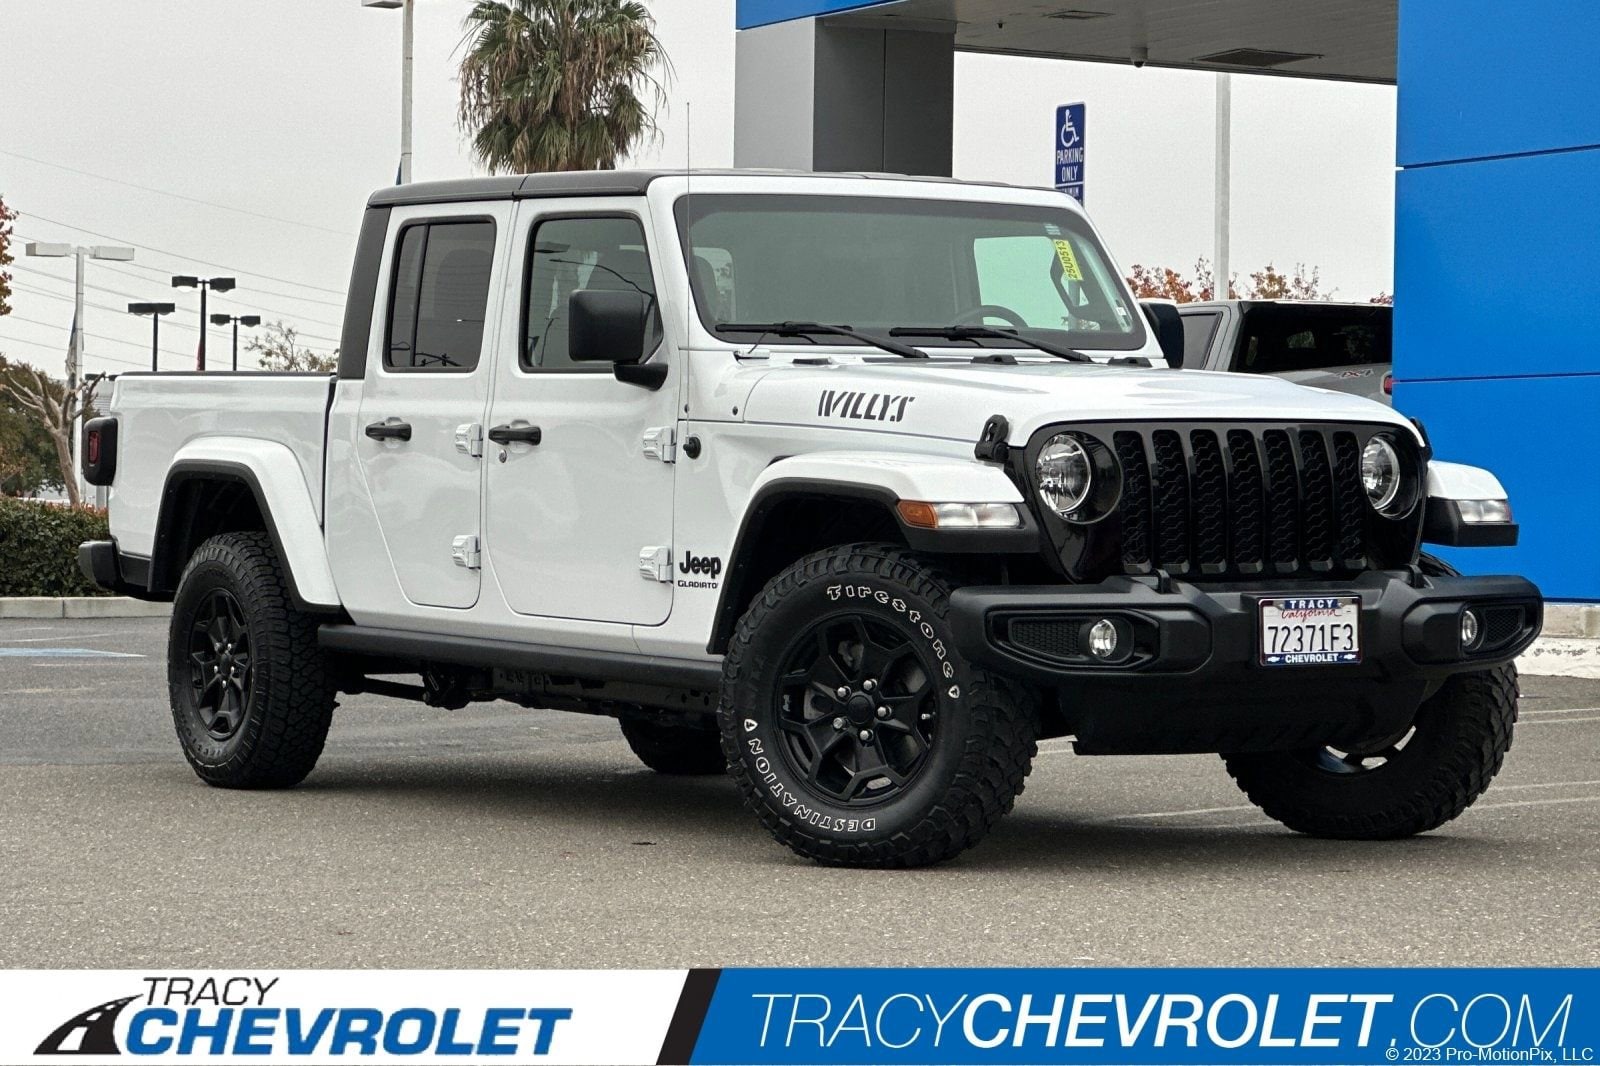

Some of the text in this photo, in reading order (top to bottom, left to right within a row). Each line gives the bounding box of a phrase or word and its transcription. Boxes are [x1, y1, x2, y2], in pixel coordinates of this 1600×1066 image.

[1057, 148, 1083, 164] PARKING
[1062, 166, 1078, 182] ONLY
[818, 390, 915, 422] WILLYS
[679, 551, 721, 579] Jeep
[678, 580, 719, 589] GLADIATO
[1290, 600, 1334, 609] TRACY
[828, 585, 954, 678] Firestone
[1268, 624, 1353, 653] 72371F3
[1285, 653, 1339, 663] CHEVROLET
[748, 738, 876, 832] DESTINATION
